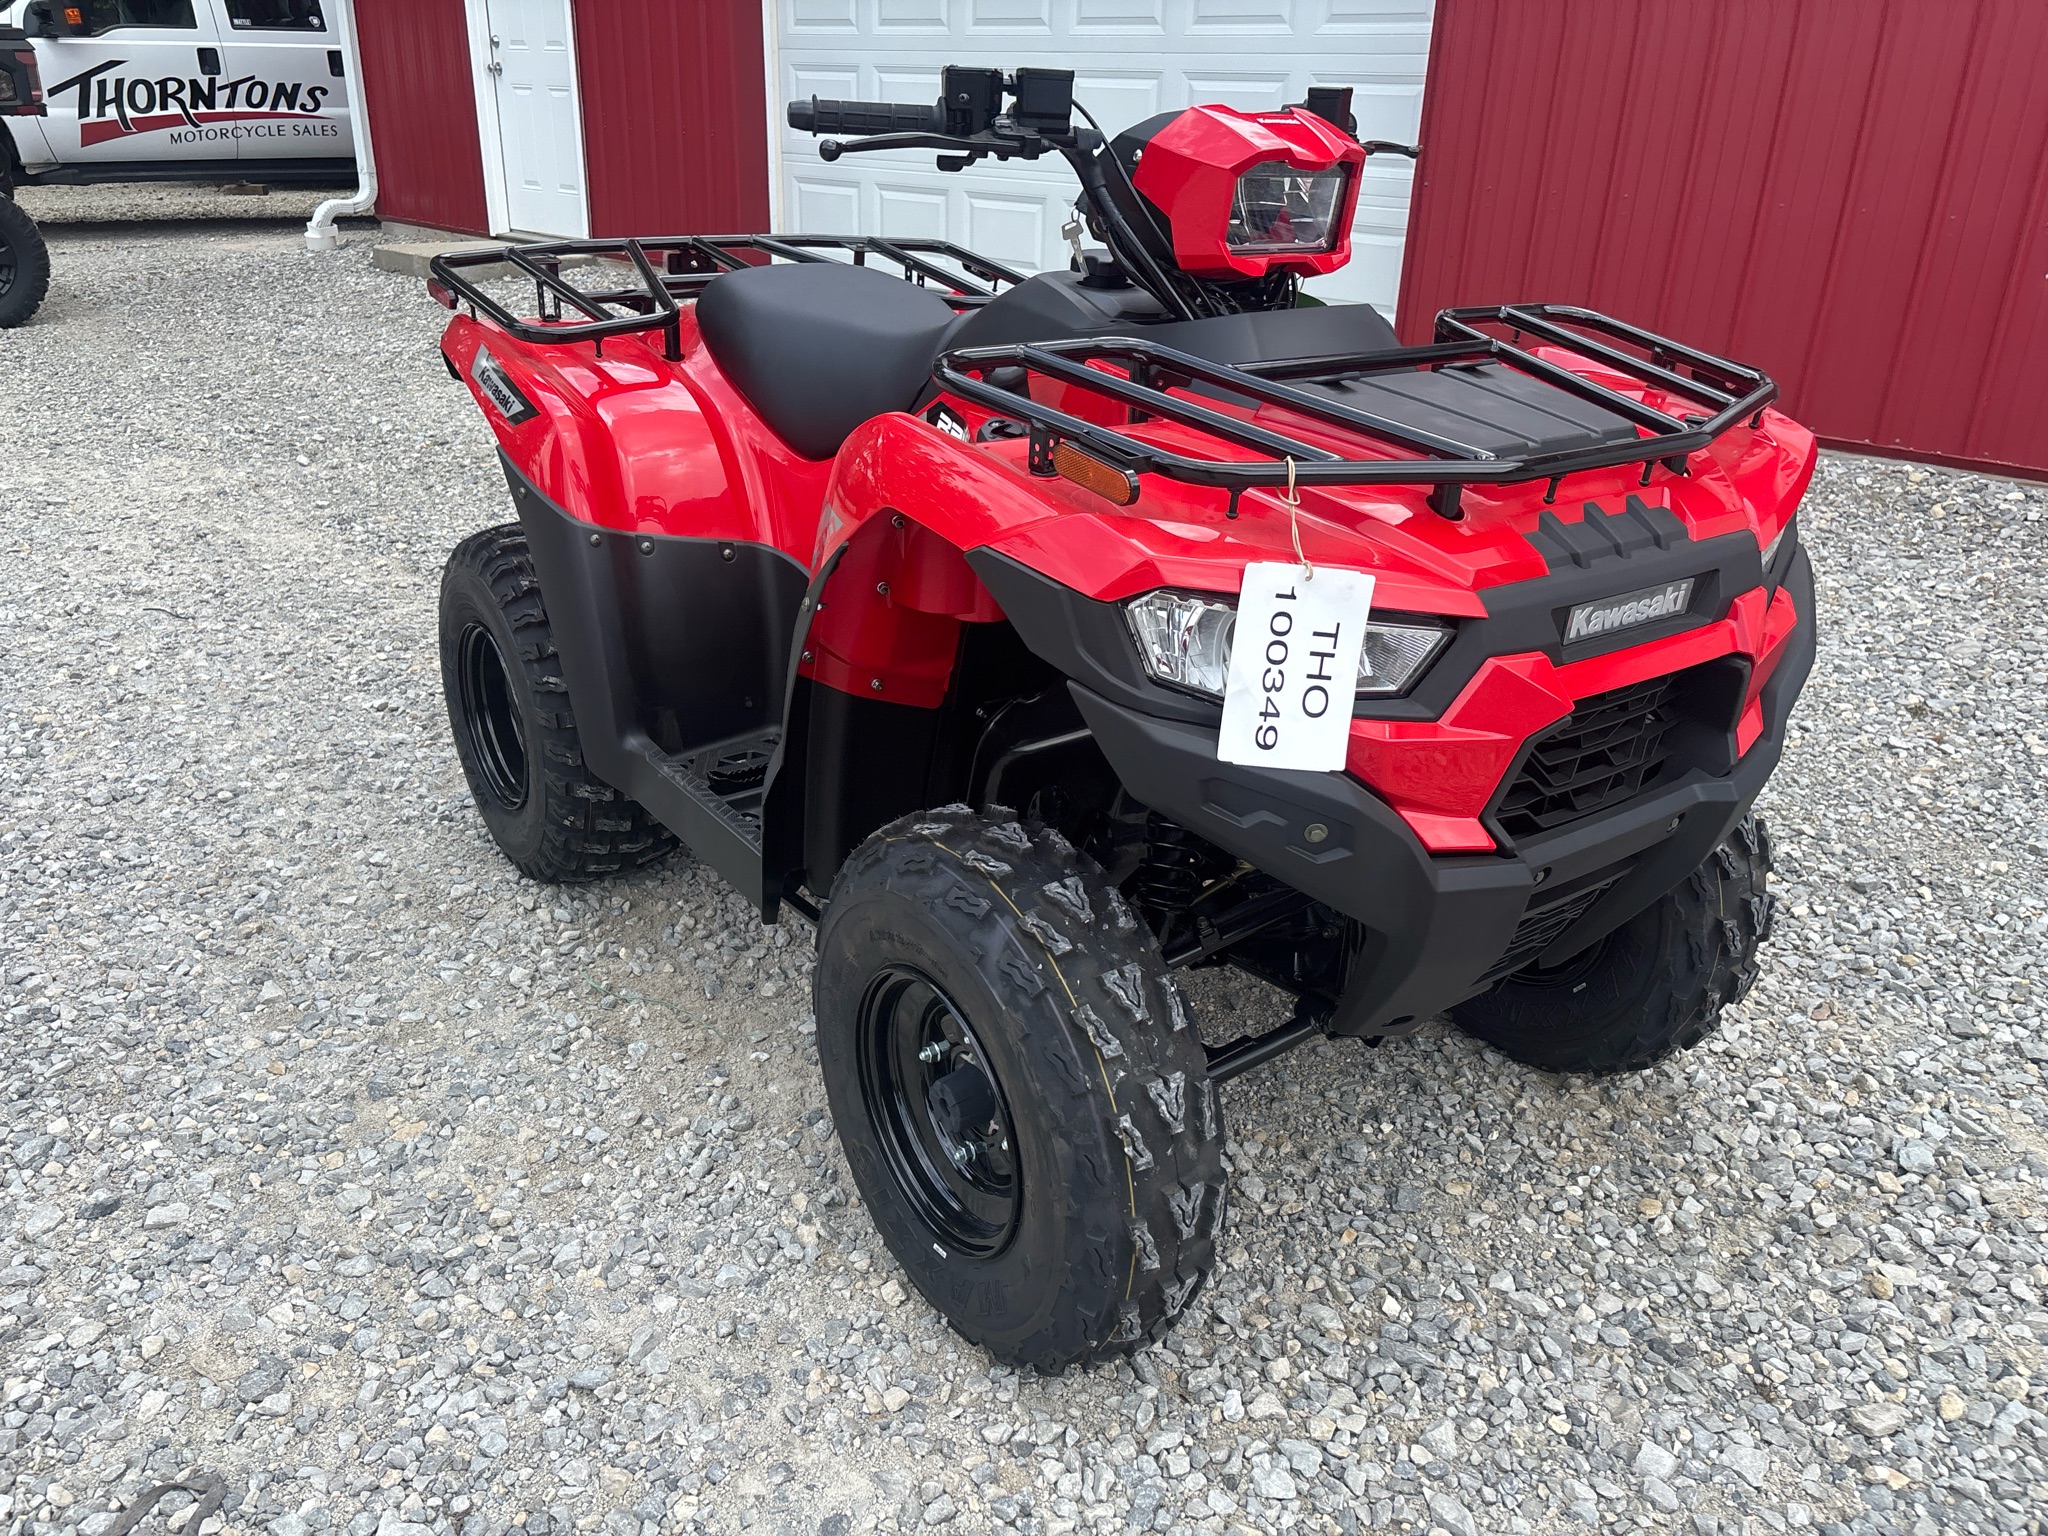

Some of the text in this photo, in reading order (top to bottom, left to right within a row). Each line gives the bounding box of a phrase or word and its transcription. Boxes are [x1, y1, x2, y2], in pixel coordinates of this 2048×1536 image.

[48, 60, 329, 132] THORNTONS
[170, 124, 338, 145] MOTORCYCLE SALES
[478, 366, 516, 414] Kawasaki
[1569, 583, 1688, 639] Kawasaki
[1302, 622, 1341, 718] THO
